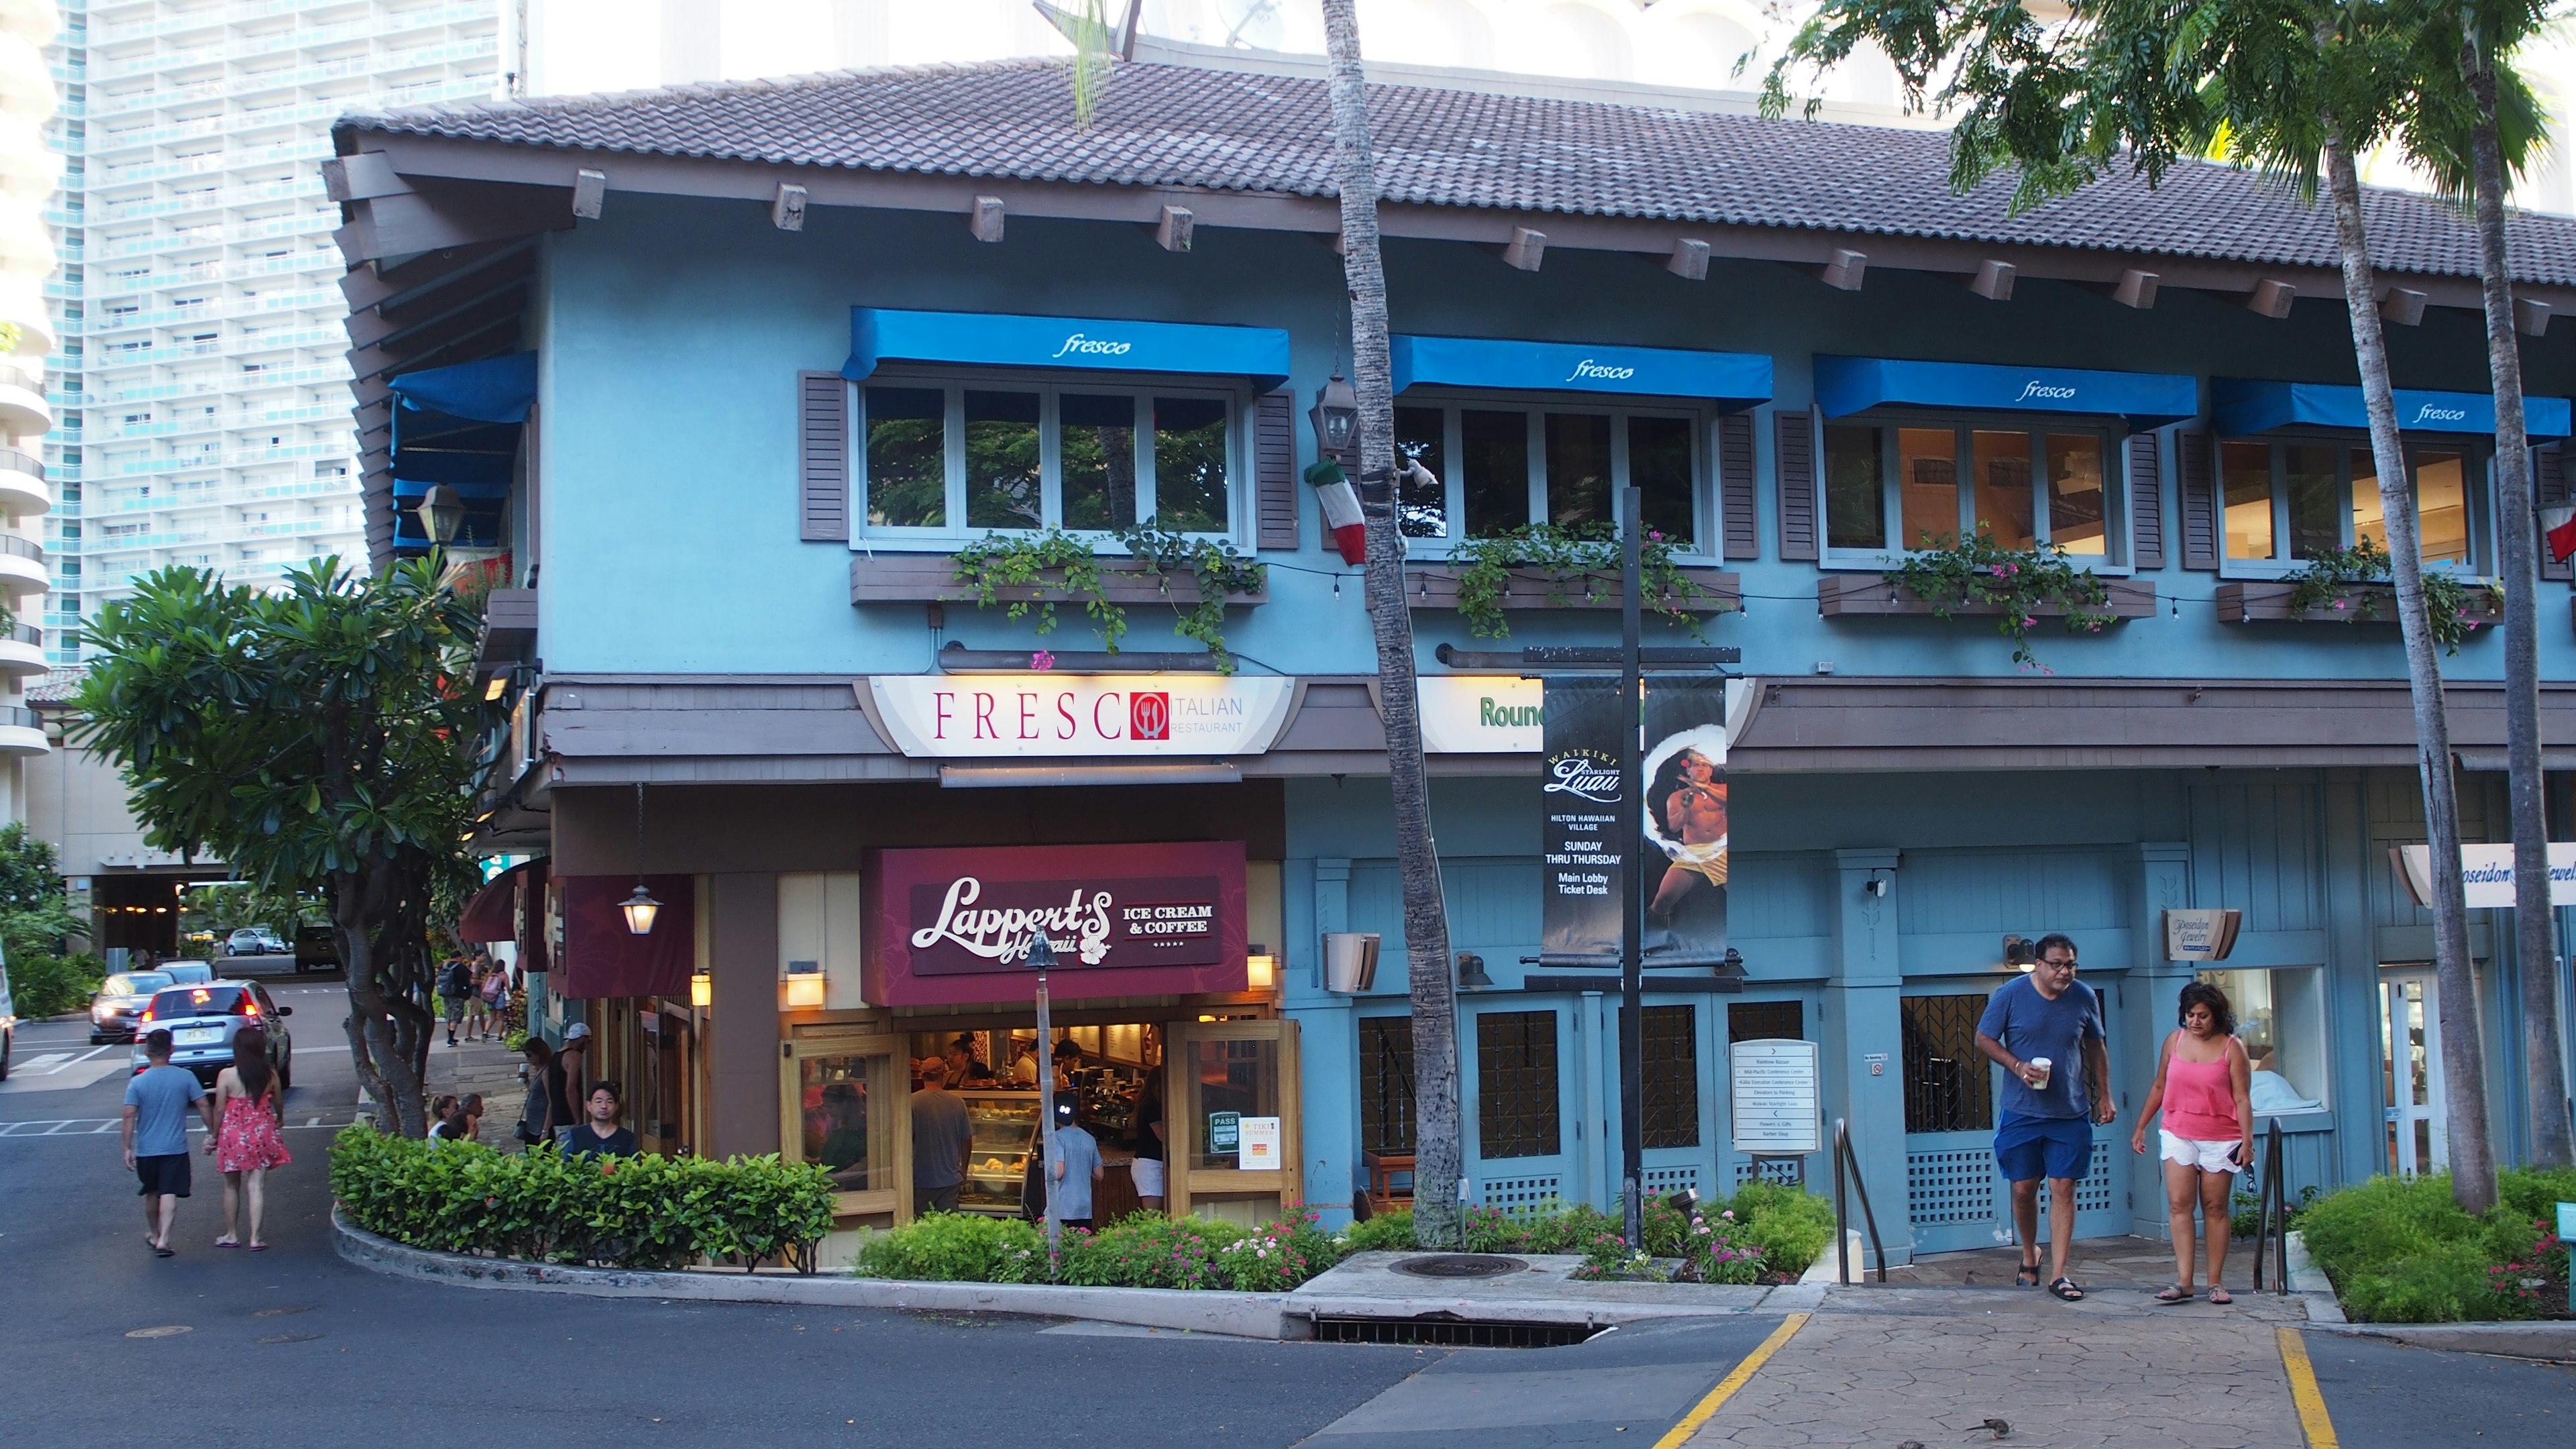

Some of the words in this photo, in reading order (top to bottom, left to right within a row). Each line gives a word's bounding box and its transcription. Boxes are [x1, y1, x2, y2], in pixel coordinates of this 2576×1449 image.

[1052, 333, 1132, 358] fresco
[1565, 359, 1635, 382] fresco
[2015, 380, 2076, 402] fresco
[2412, 403, 2466, 424] fresco
[1170, 697, 1242, 716] ITALIAN
[1170, 722, 1243, 733] RESTAURANT
[1548, 749, 1618, 766] WAIKIKI
[1544, 759, 1623, 803] Luau
[1550, 814, 1576, 822] HILTON
[1578, 814, 1615, 822] HAWAIIAN
[1568, 823, 1598, 831] VILLAGE
[1564, 841, 1603, 851] SUNDAY
[1545, 854, 1570, 864] THRU
[1572, 854, 1621, 865] THURSDAY
[1558, 872, 1580, 883] Main
[1582, 872, 1609, 885] Lobby
[2463, 861, 2511, 883] oseidon
[1558, 884, 1585, 894] Ticket
[1586, 884, 1608, 895] Desk
[1122, 908, 1151, 920] ICE
[1154, 906, 1213, 919] CREAM
[1129, 922, 1143, 934] &
[1144, 920, 1208, 934] COFFEE
[2173, 918, 2209, 935] Poseidon
[2176, 930, 2207, 950] Jewelry
[1214, 1118, 1236, 1126] PASS
